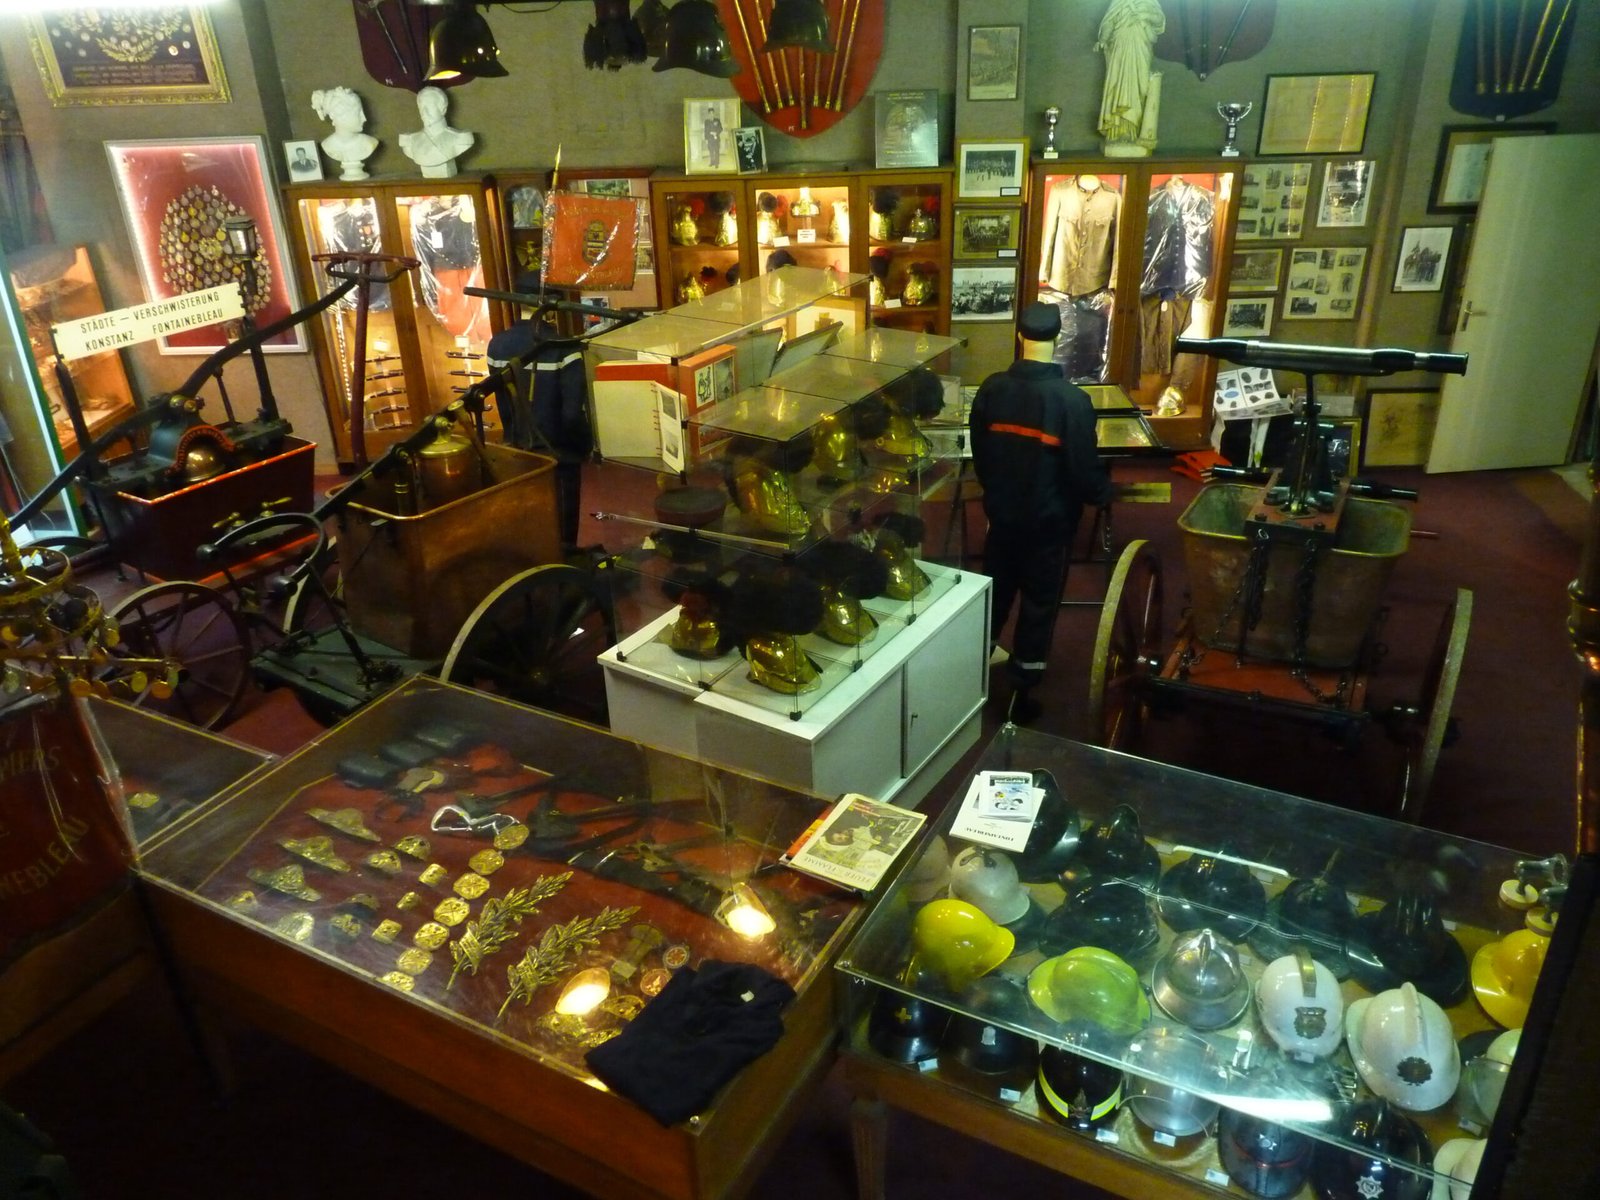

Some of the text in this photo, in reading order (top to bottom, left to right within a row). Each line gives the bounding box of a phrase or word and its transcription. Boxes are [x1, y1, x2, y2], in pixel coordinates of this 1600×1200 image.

[80, 316, 116, 334] STÄDTE
[132, 291, 220, 321] VERSCHWISTERUNG
[85, 308, 223, 352] KONSTANZ FONTAINEBLEAU
